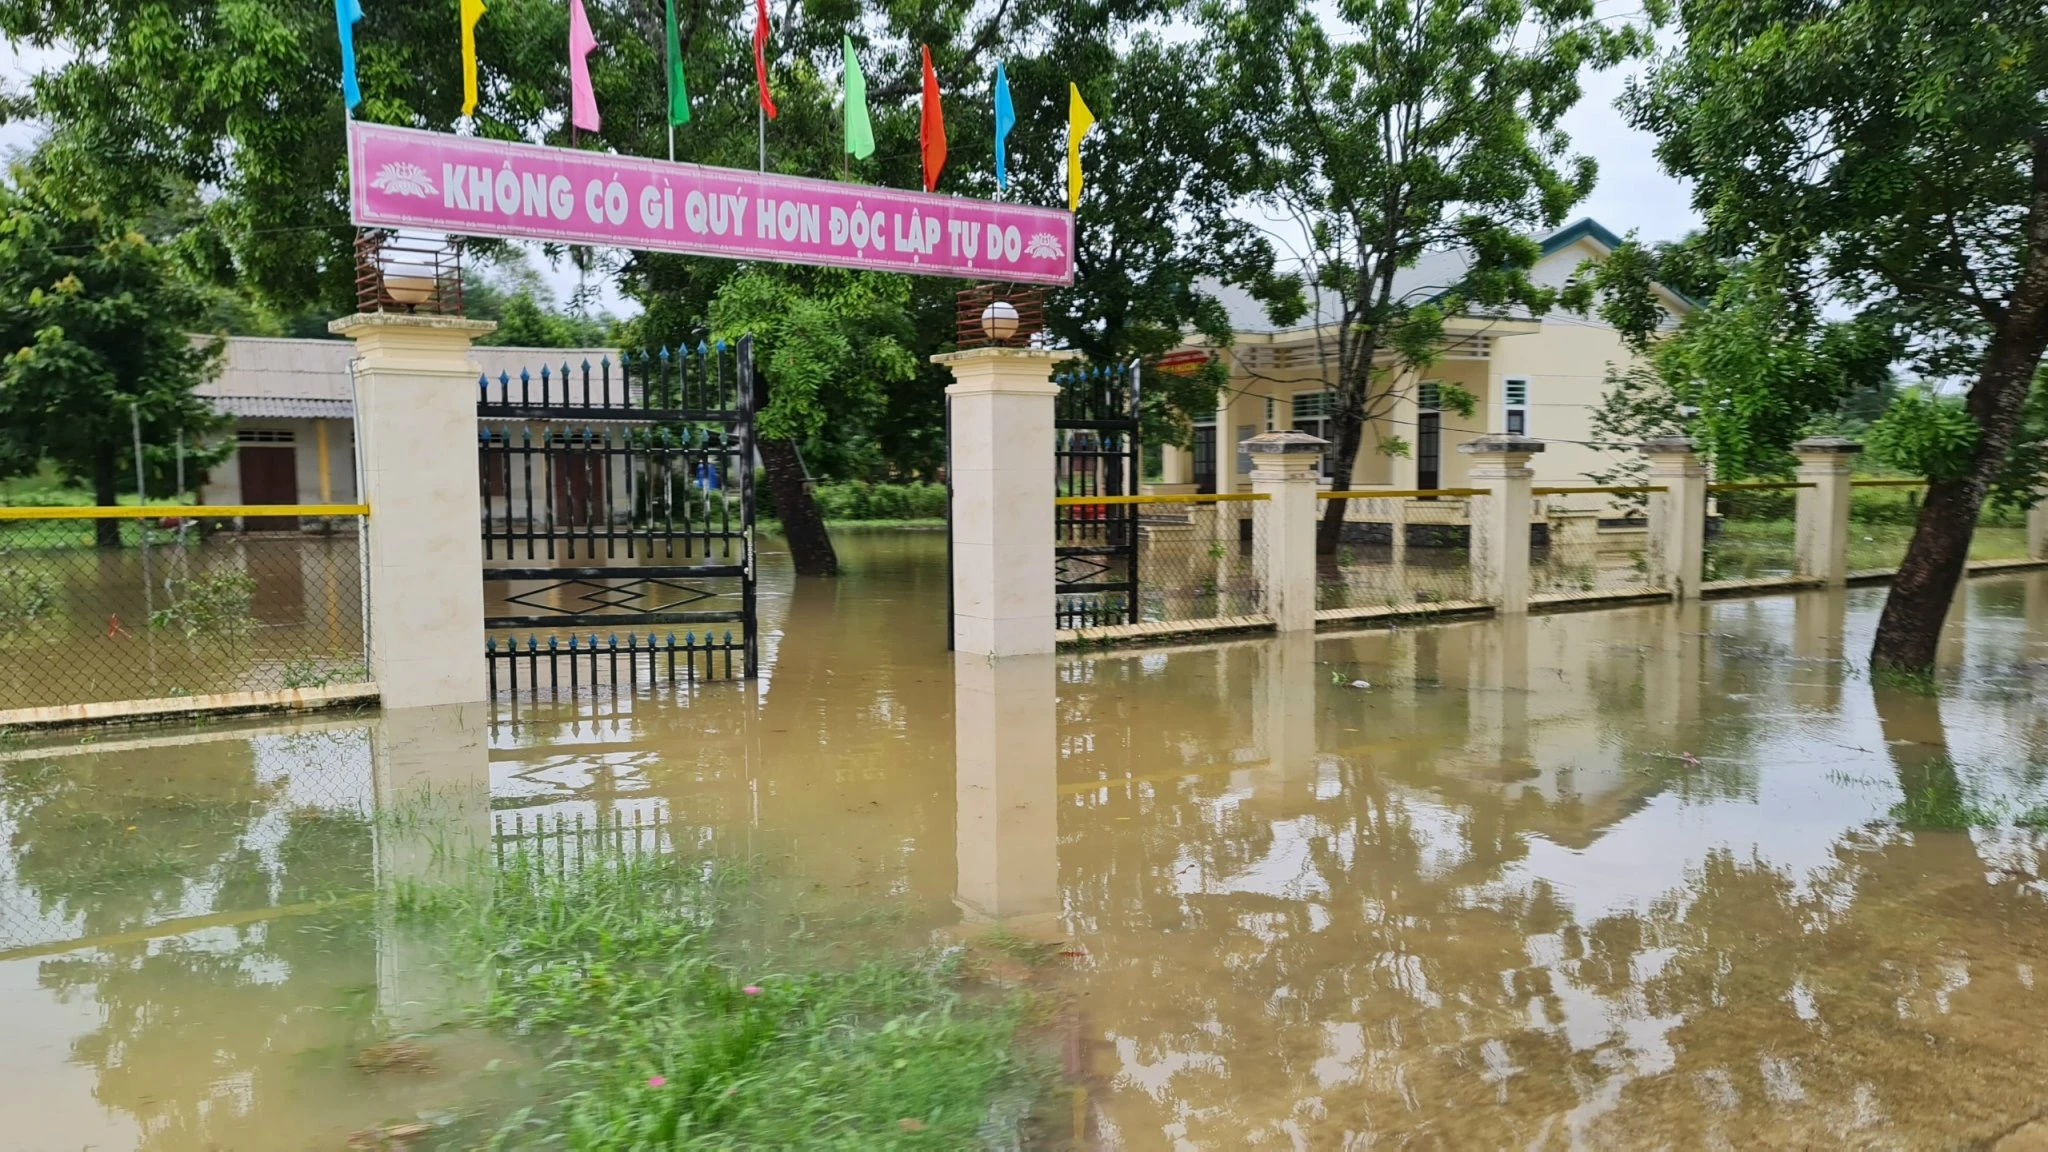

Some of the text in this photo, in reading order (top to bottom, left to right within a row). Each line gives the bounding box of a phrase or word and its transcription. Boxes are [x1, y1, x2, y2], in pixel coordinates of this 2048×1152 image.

[442, 160, 1021, 268] KHÔNG CÓ GÌ QUÝ HƠN ĐỘC LẬP TỰ DO
